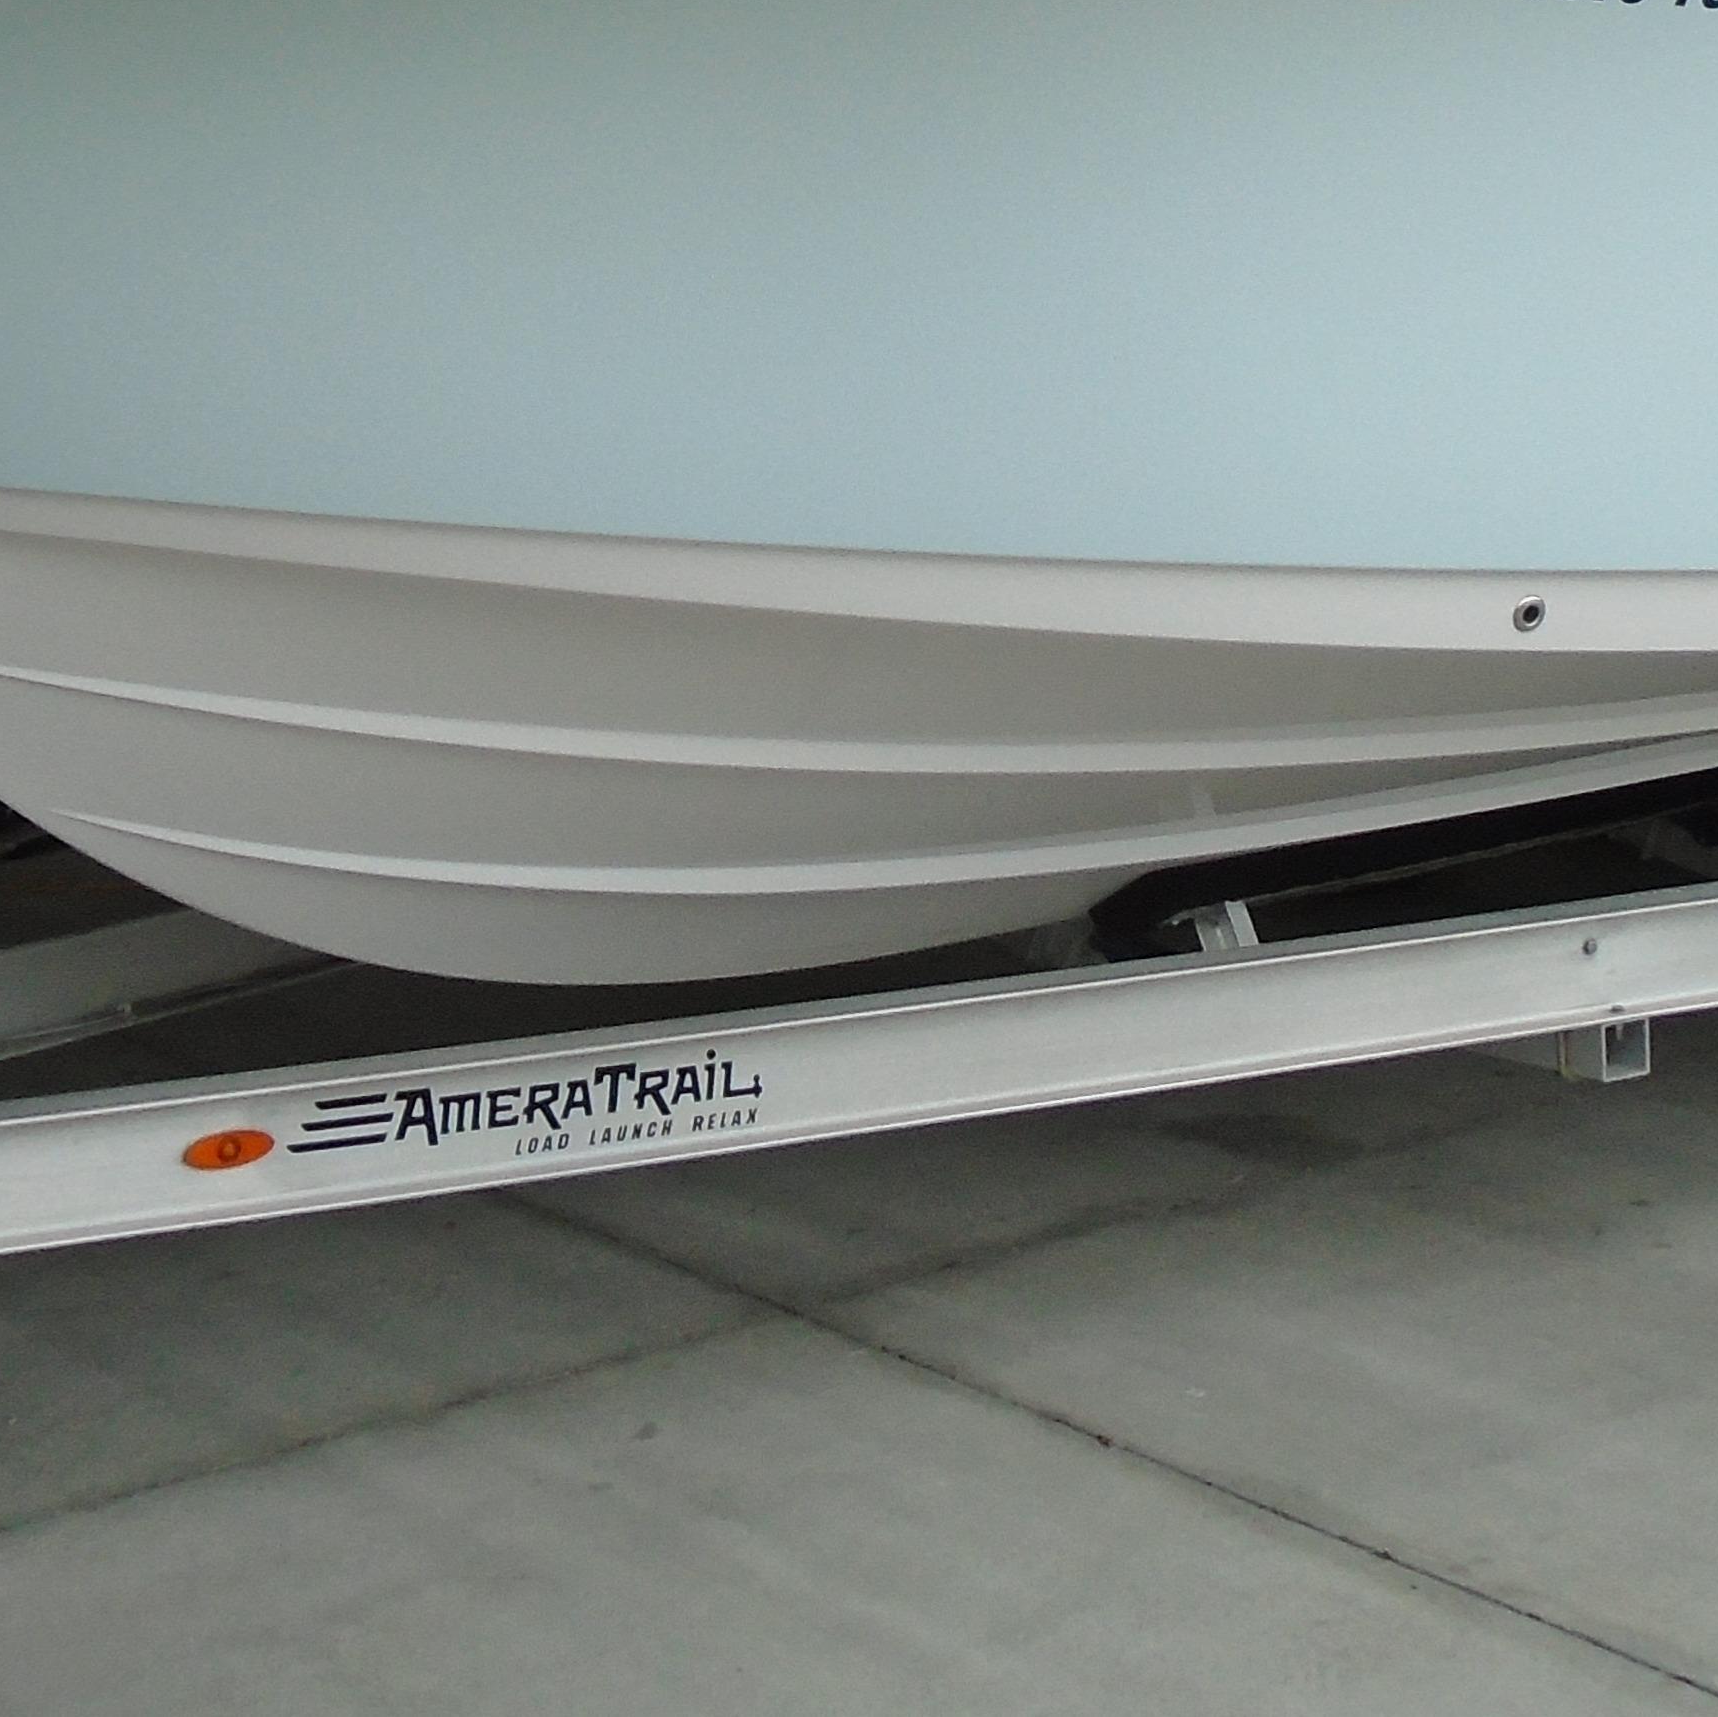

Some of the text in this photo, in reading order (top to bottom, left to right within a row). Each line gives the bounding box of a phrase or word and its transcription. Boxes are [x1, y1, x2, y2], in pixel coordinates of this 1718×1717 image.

[515, 1107, 760, 1156] LOAD LAUNCH RELAX
